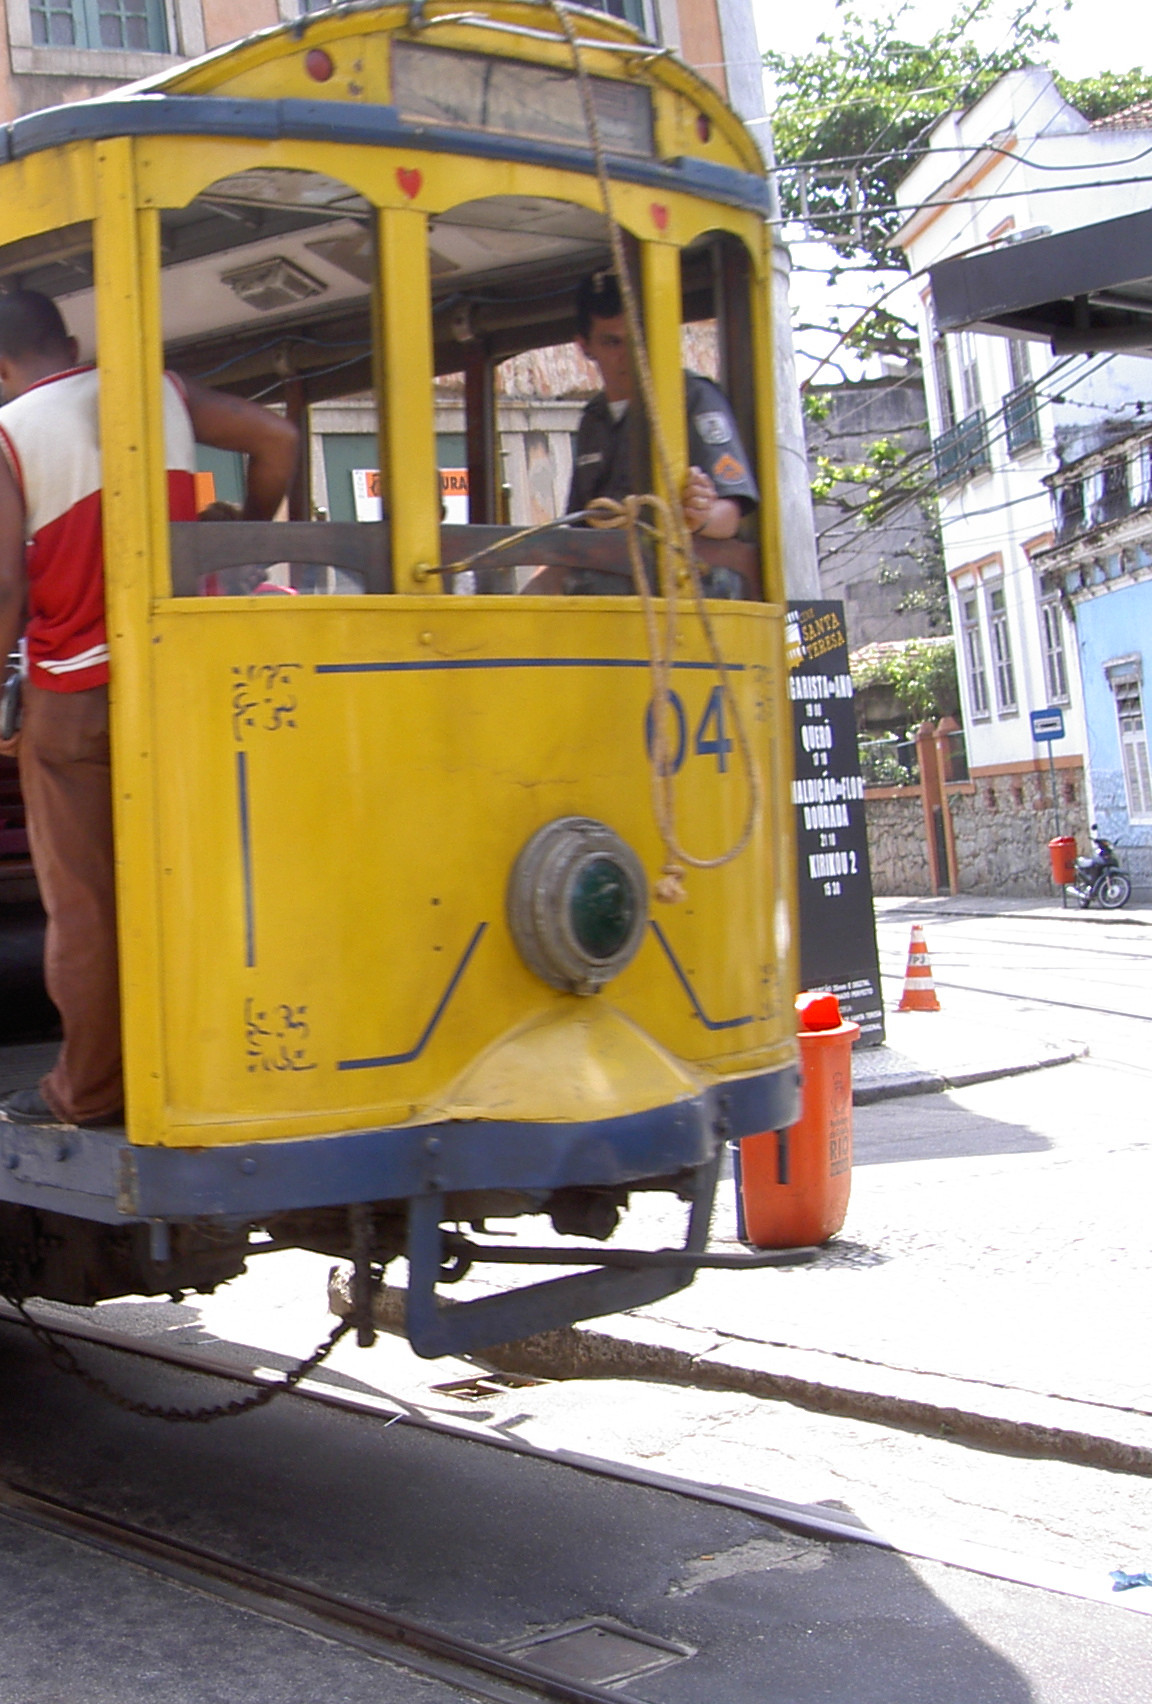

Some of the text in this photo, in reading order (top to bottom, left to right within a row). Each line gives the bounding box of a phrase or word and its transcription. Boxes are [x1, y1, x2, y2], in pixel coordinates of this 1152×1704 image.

[801, 612, 841, 643] SANTA
[806, 630, 847, 660] TERESA
[788, 675, 830, 700] GARISTA
[645, 685, 733, 777] 04
[808, 850, 858, 879] KIRIKOU 2
